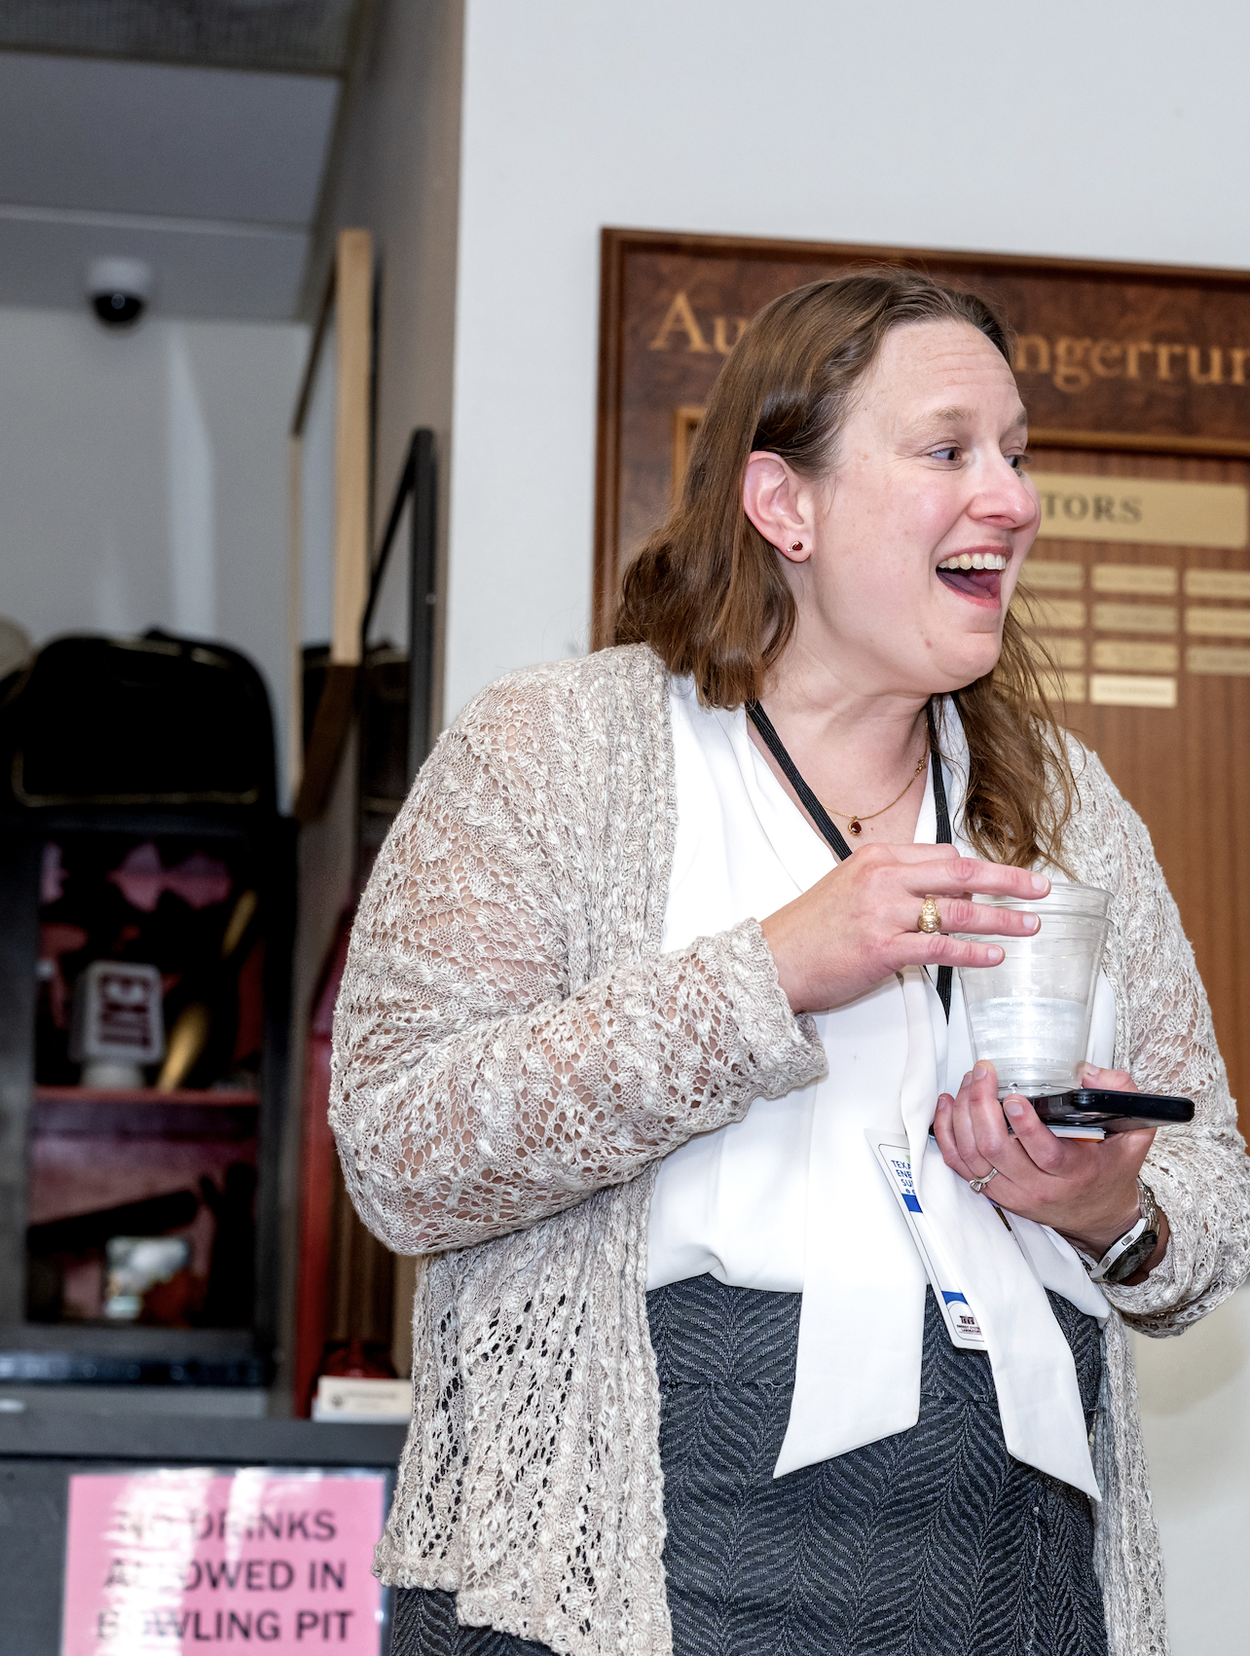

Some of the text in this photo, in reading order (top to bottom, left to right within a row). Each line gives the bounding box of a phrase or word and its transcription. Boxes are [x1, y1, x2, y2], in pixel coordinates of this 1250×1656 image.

[1041, 492, 1143, 525] TORS
[104, 1559, 346, 1591] AOWED IN
[295, 1610, 354, 1642] PIT
